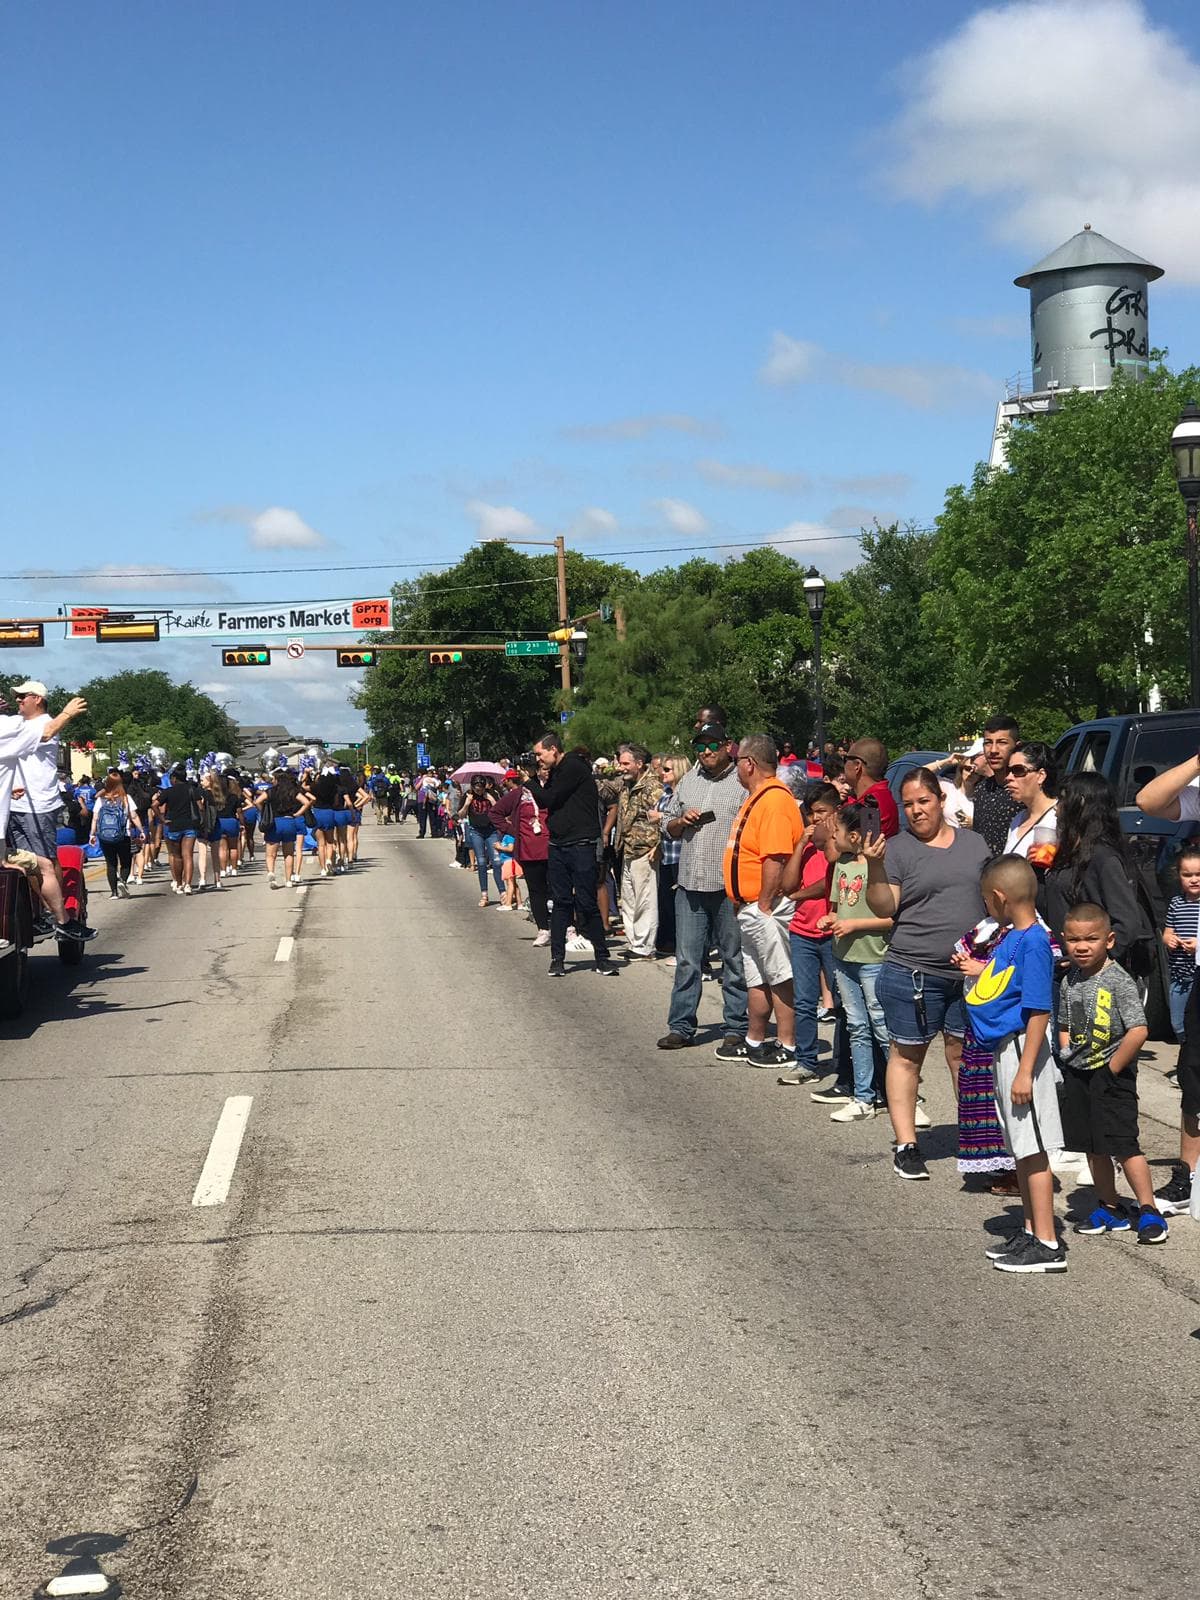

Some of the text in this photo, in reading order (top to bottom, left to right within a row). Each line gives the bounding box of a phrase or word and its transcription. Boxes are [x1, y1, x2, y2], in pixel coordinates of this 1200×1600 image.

[356, 604, 387, 614] GPTX
[218, 612, 286, 630] Farmers
[290, 609, 350, 628] Market
[360, 616, 382, 626] .org
